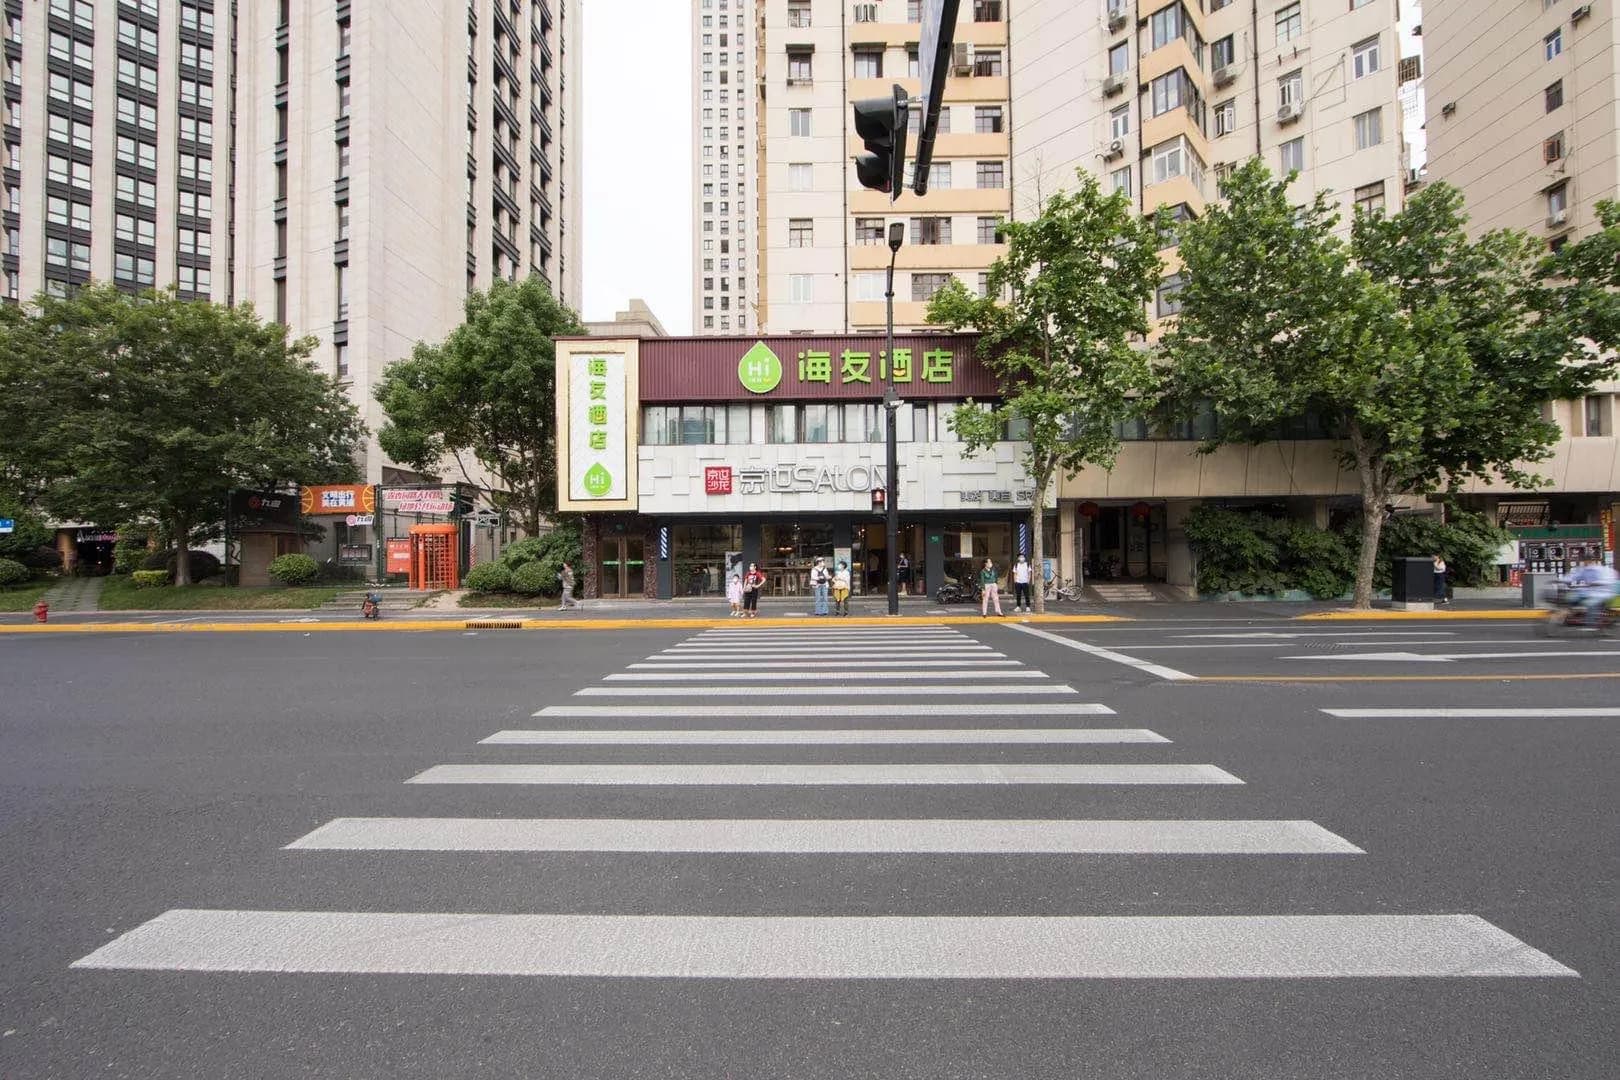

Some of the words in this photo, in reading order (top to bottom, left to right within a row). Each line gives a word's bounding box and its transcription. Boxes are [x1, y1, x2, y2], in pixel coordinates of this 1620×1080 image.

[748, 357, 769, 377] Hi
[798, 348, 954, 384] 海友酒店
[588, 358, 608, 450] 海友酒店
[590, 472, 605, 485] Hi
[1016, 490, 1036, 502] SP
